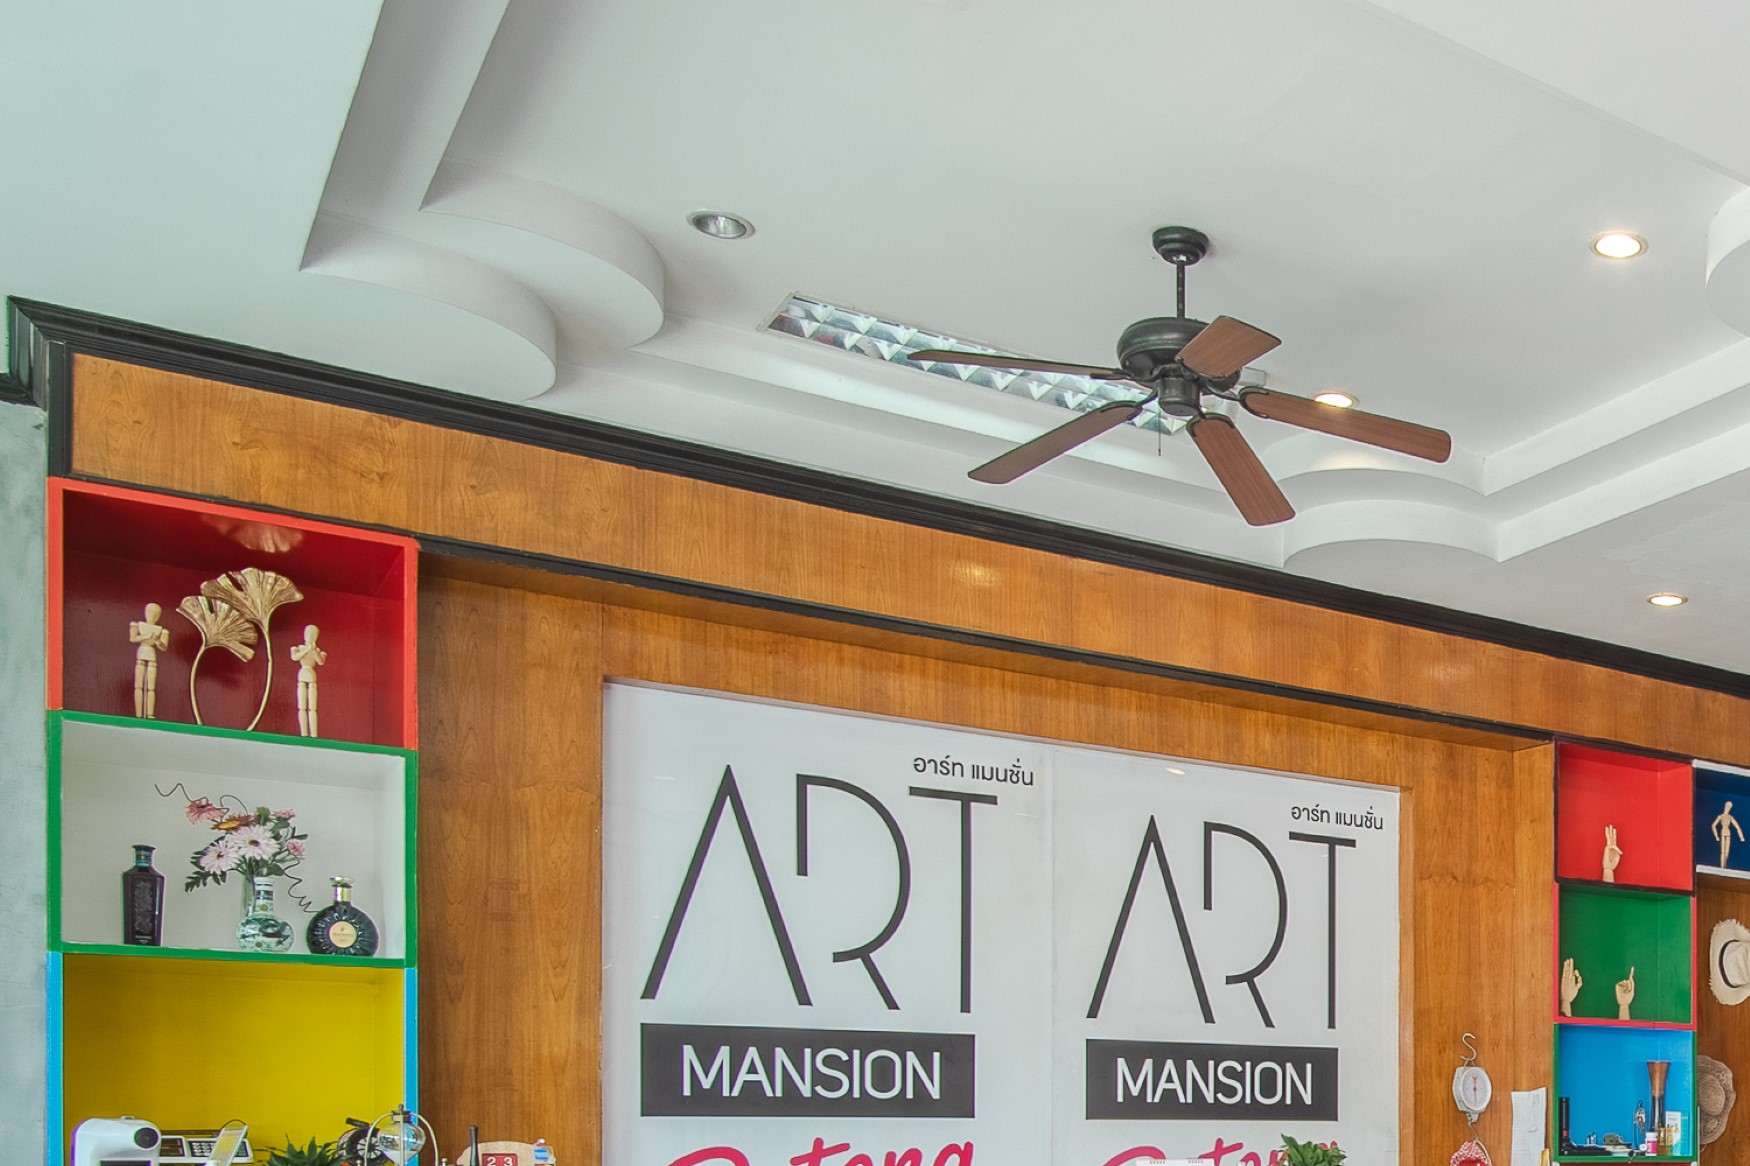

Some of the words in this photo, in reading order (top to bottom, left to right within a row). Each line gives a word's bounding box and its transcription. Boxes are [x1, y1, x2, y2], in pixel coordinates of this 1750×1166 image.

[913, 755, 964, 778] อาร์ท
[971, 758, 1034, 786] แมนชั่น
[1290, 803, 1331, 823] อาร์ท
[1335, 806, 1383, 830] แมนชั่น
[641, 765, 998, 1013] ART
[1086, 814, 1356, 1030] ART
[681, 1043, 941, 1100] MANSION
[1116, 1057, 1312, 1105] MANSION
